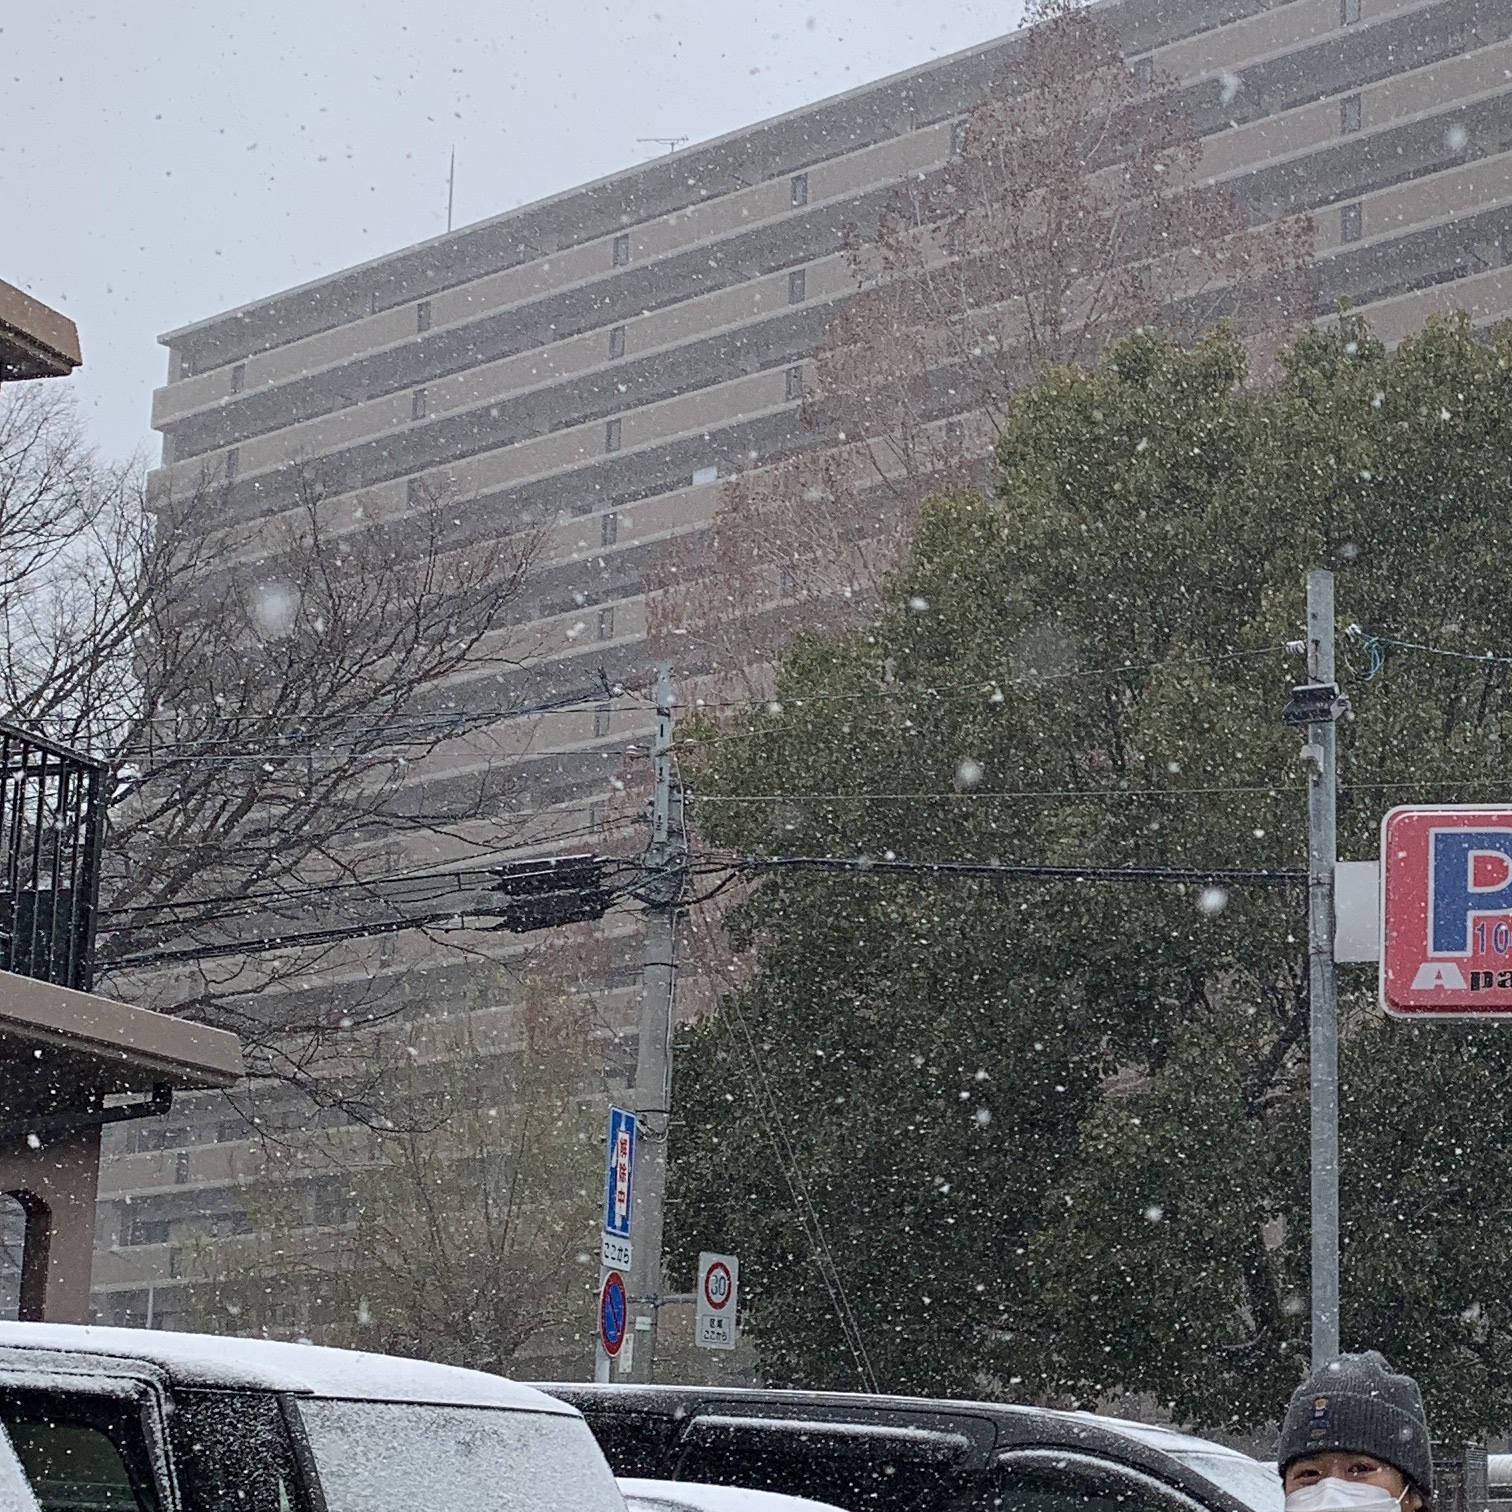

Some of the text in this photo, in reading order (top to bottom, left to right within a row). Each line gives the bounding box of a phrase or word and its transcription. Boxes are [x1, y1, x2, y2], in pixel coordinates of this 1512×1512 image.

[604, 1242, 630, 1265] ここから
[711, 1274, 726, 1297] 30
[703, 1330, 728, 1341] ここから
